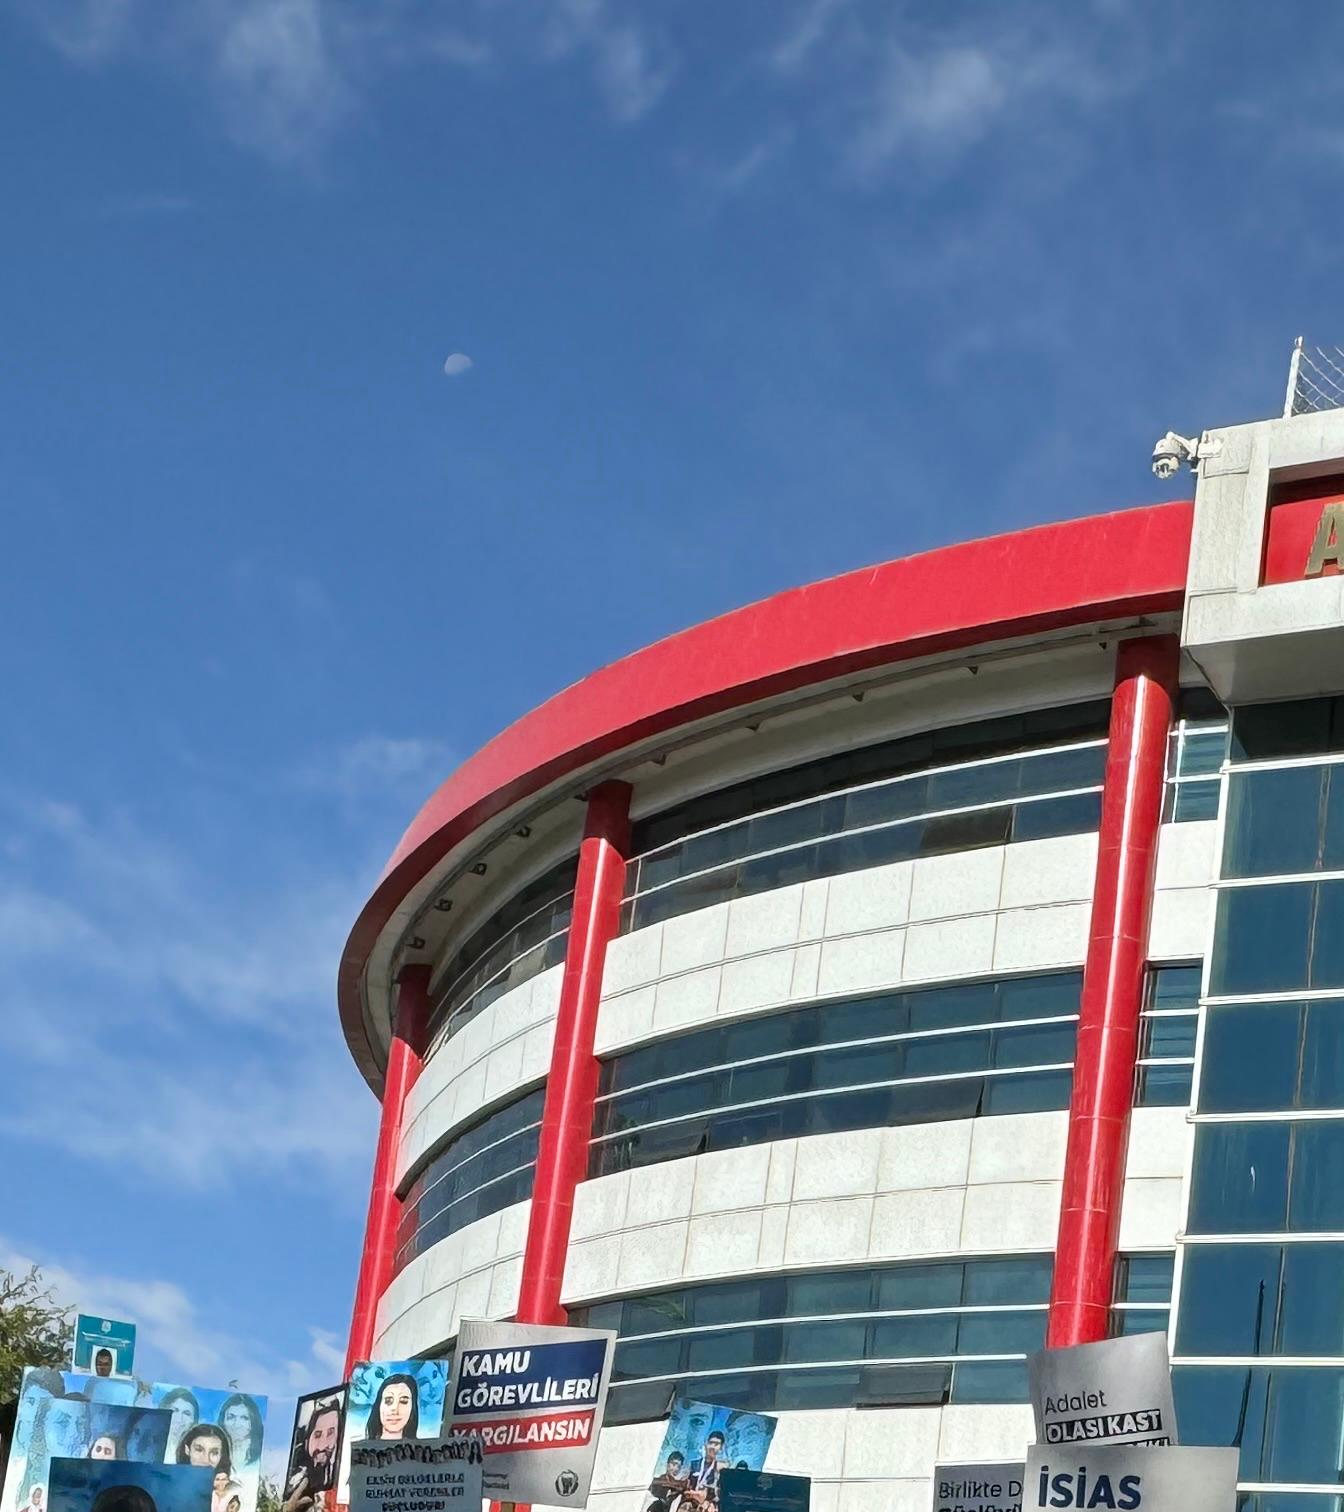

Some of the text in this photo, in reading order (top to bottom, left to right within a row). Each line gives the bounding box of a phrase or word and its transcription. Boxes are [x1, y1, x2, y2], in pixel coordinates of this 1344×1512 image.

[462, 1350, 531, 1377] KAMU
[457, 1373, 599, 1408] GÖREVLİLERİ
[1044, 1390, 1107, 1415] Adalet
[1046, 1417, 1103, 1443] OLASI
[1108, 1409, 1161, 1436] KAST
[939, 1481, 1003, 1500] Birlikte
[1037, 1464, 1142, 1510] İSİAS
